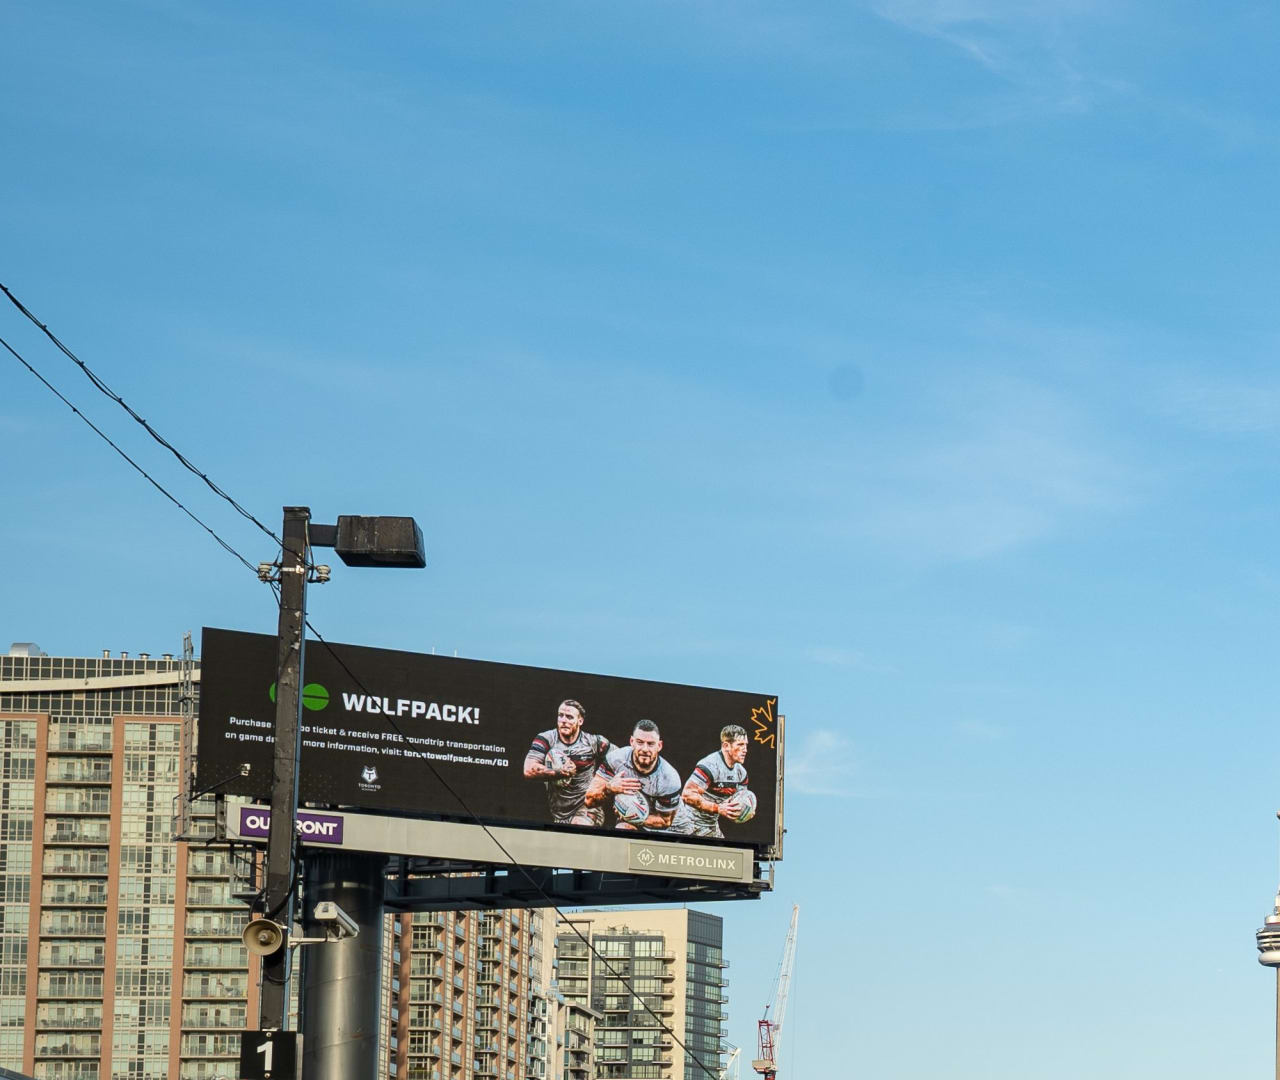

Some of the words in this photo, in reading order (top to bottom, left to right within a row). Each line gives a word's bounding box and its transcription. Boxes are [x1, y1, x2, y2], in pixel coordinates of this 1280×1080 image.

[342, 692, 480, 725] WOLFPACK!
[225, 732, 237, 740] on
[238, 733, 264, 742] game
[302, 740, 326, 748] more
[229, 716, 272, 729] Purchase
[312, 726, 338, 735] ticket
[339, 728, 346, 736] &
[347, 730, 380, 740] receive
[381, 733, 404, 743] FREE
[405, 736, 444, 748] roundtrip
[446, 741, 506, 753] transportation
[246, 815, 338, 836] OURONT
[658, 853, 736, 870] METROLINX
[257, 1041, 273, 1071] 1
